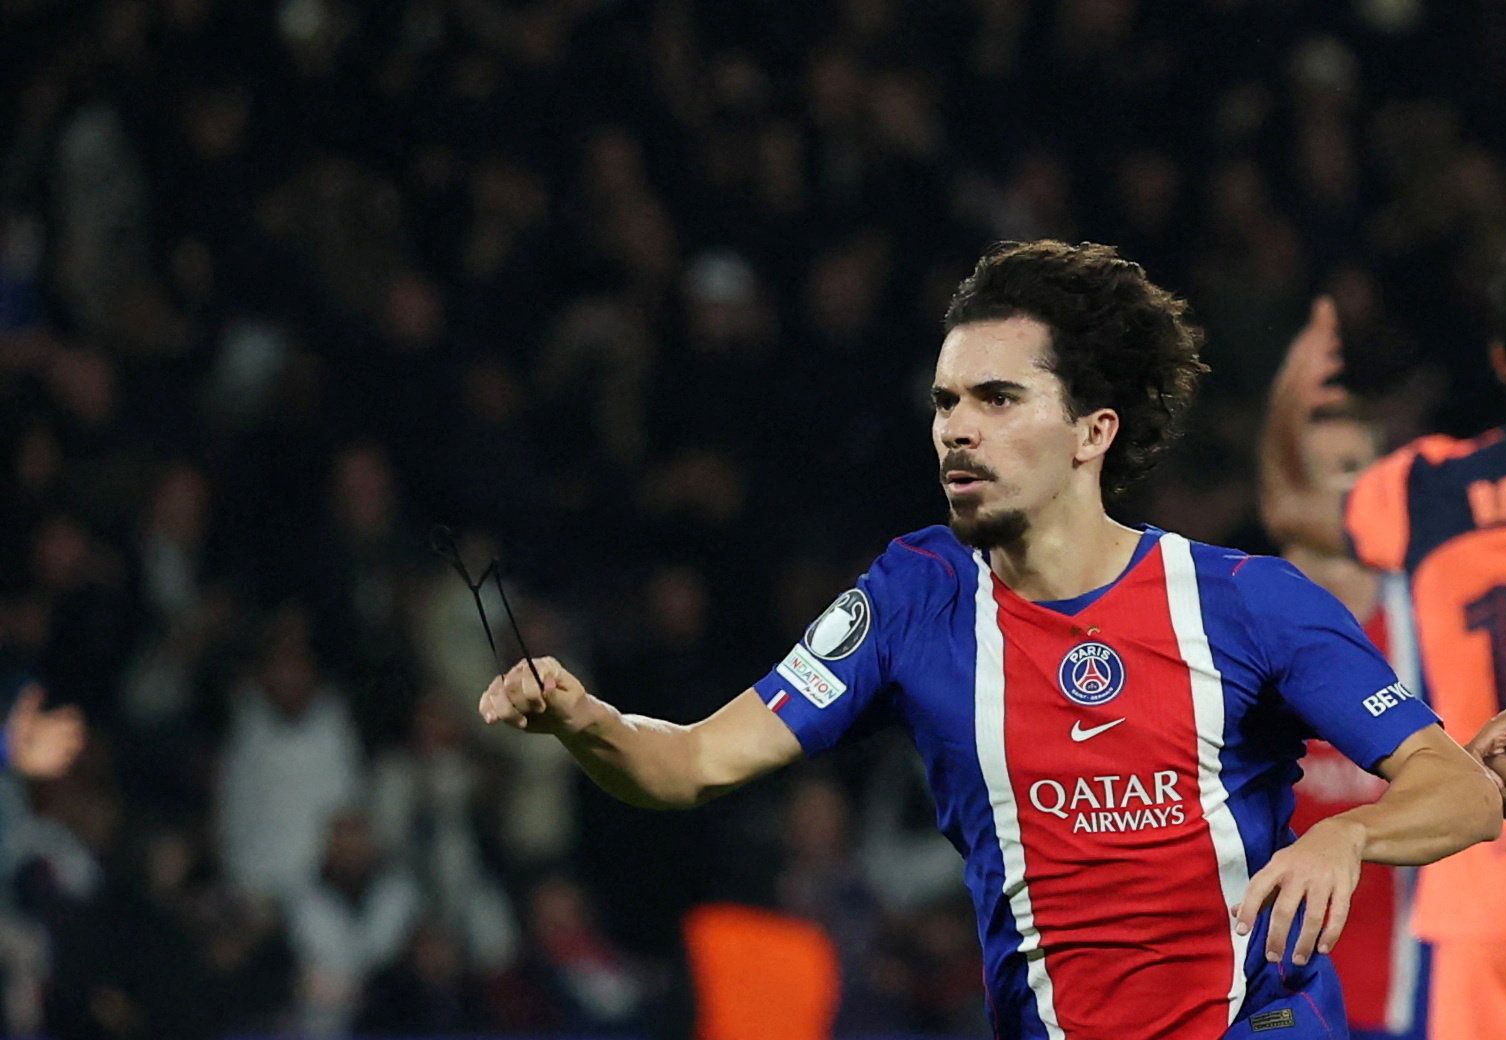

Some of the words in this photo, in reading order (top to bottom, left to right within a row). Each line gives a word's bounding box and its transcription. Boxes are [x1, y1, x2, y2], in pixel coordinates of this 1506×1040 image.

[1069, 646, 1111, 664] PARIS
[791, 657, 836, 699] NDATION
[1029, 770, 1183, 819] QATAR
[1072, 804, 1185, 834] AIRWAYS
